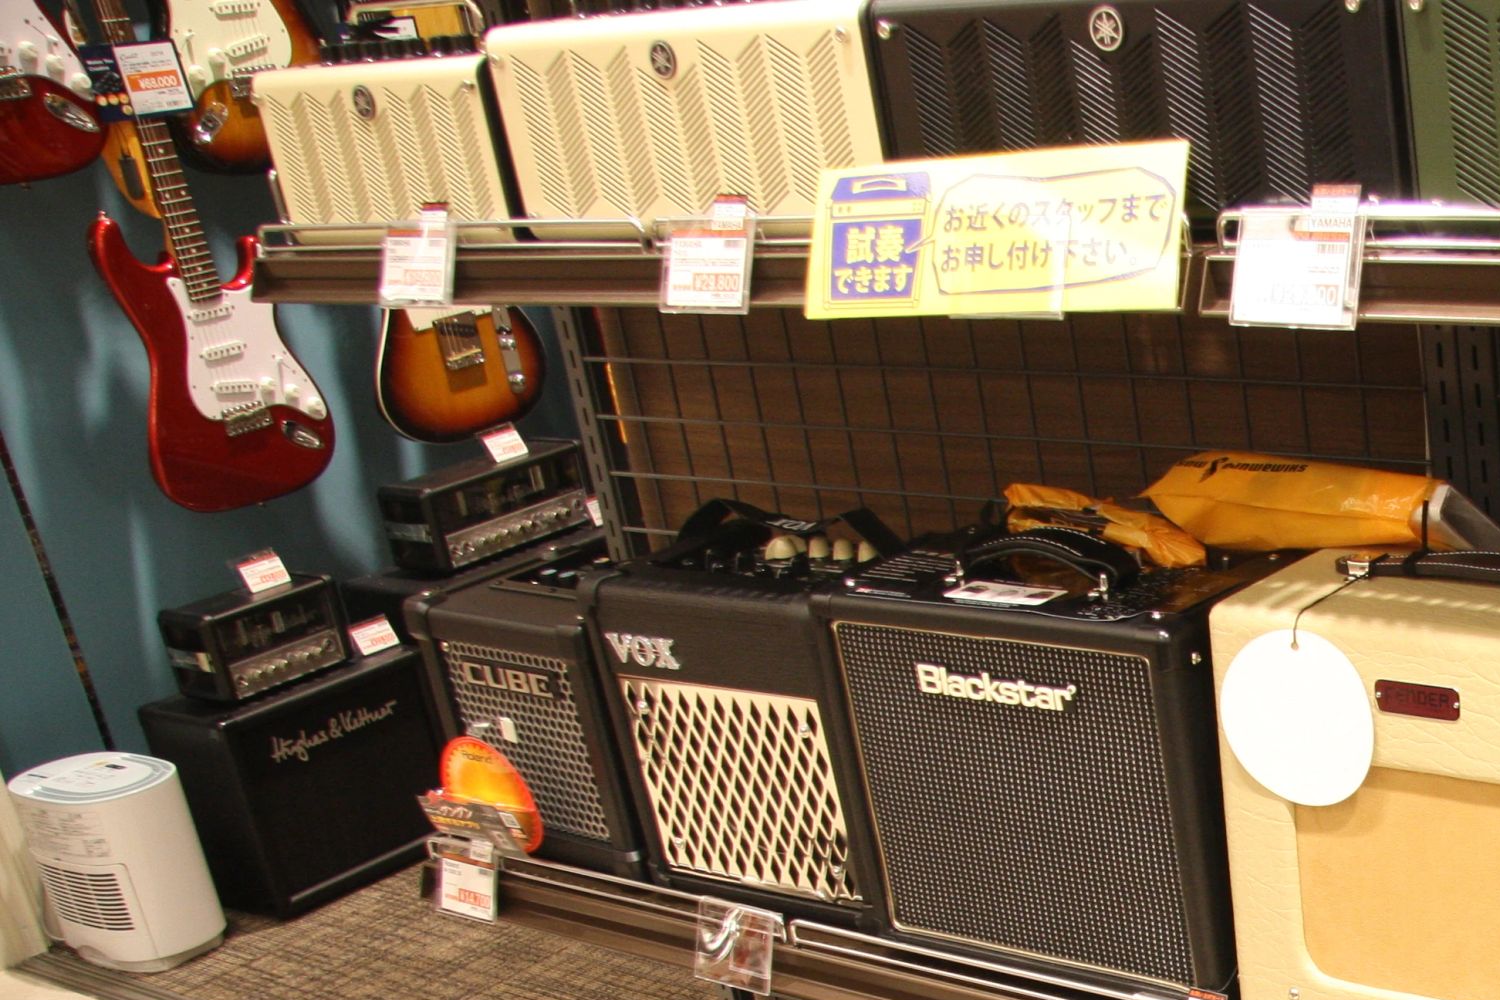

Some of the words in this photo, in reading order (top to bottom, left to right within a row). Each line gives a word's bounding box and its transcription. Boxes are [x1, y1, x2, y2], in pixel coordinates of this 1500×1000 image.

[943, 193, 1168, 233] お近くのスタッフまで
[846, 226, 905, 263] 試奏
[834, 264, 913, 294] できます
[604, 632, 681, 670] VOX
[462, 661, 554, 698] CUBE
[916, 663, 1073, 711] Blackstar
[329, 717, 344, 738] &
